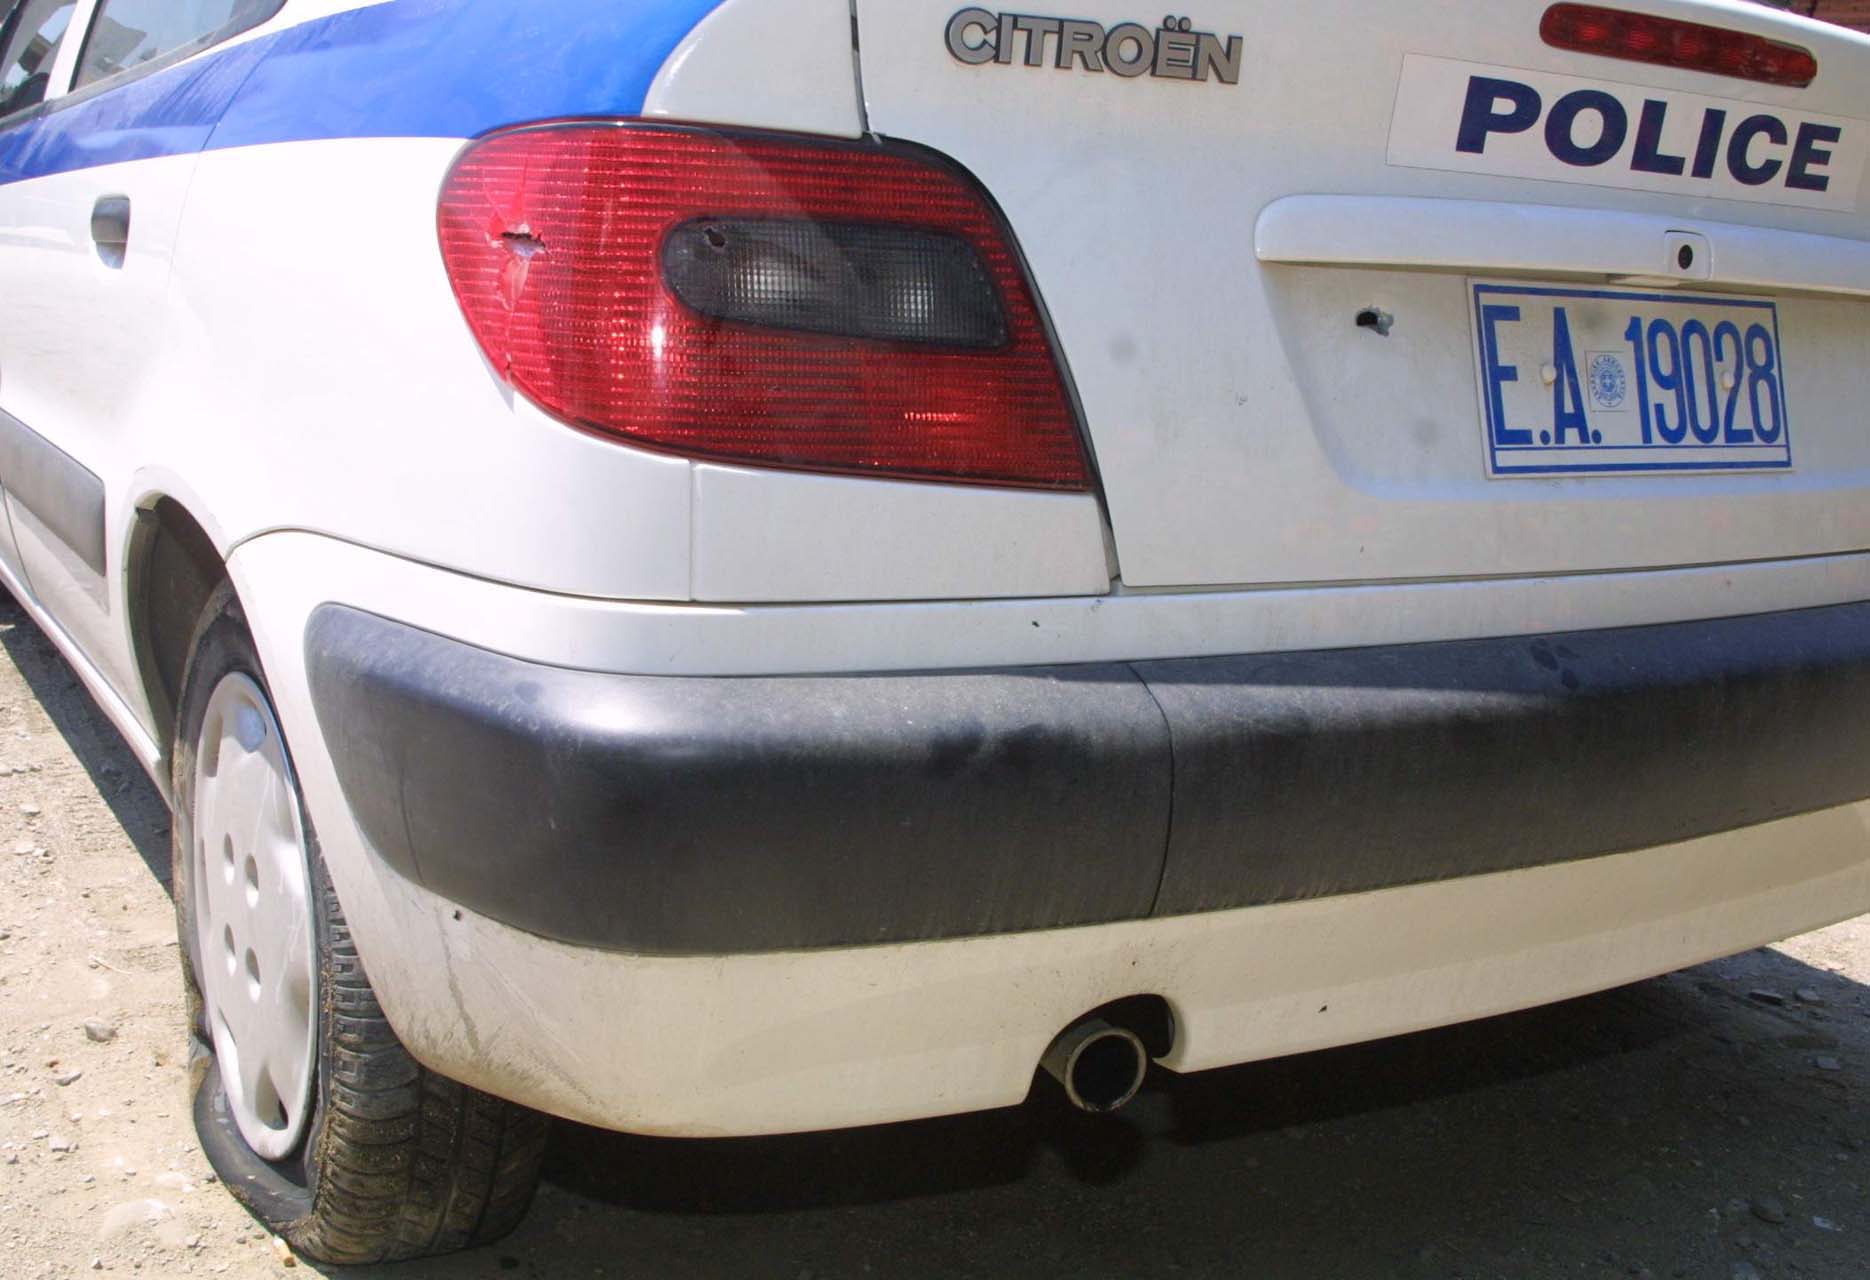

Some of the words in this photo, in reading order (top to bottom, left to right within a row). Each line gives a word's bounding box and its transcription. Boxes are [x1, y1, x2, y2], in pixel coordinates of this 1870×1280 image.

[944, 7, 1243, 84] CITROËN
[1456, 75, 1841, 192] POLICE
[1482, 305, 1602, 445] E.A.
[1624, 316, 1781, 444] 19028
